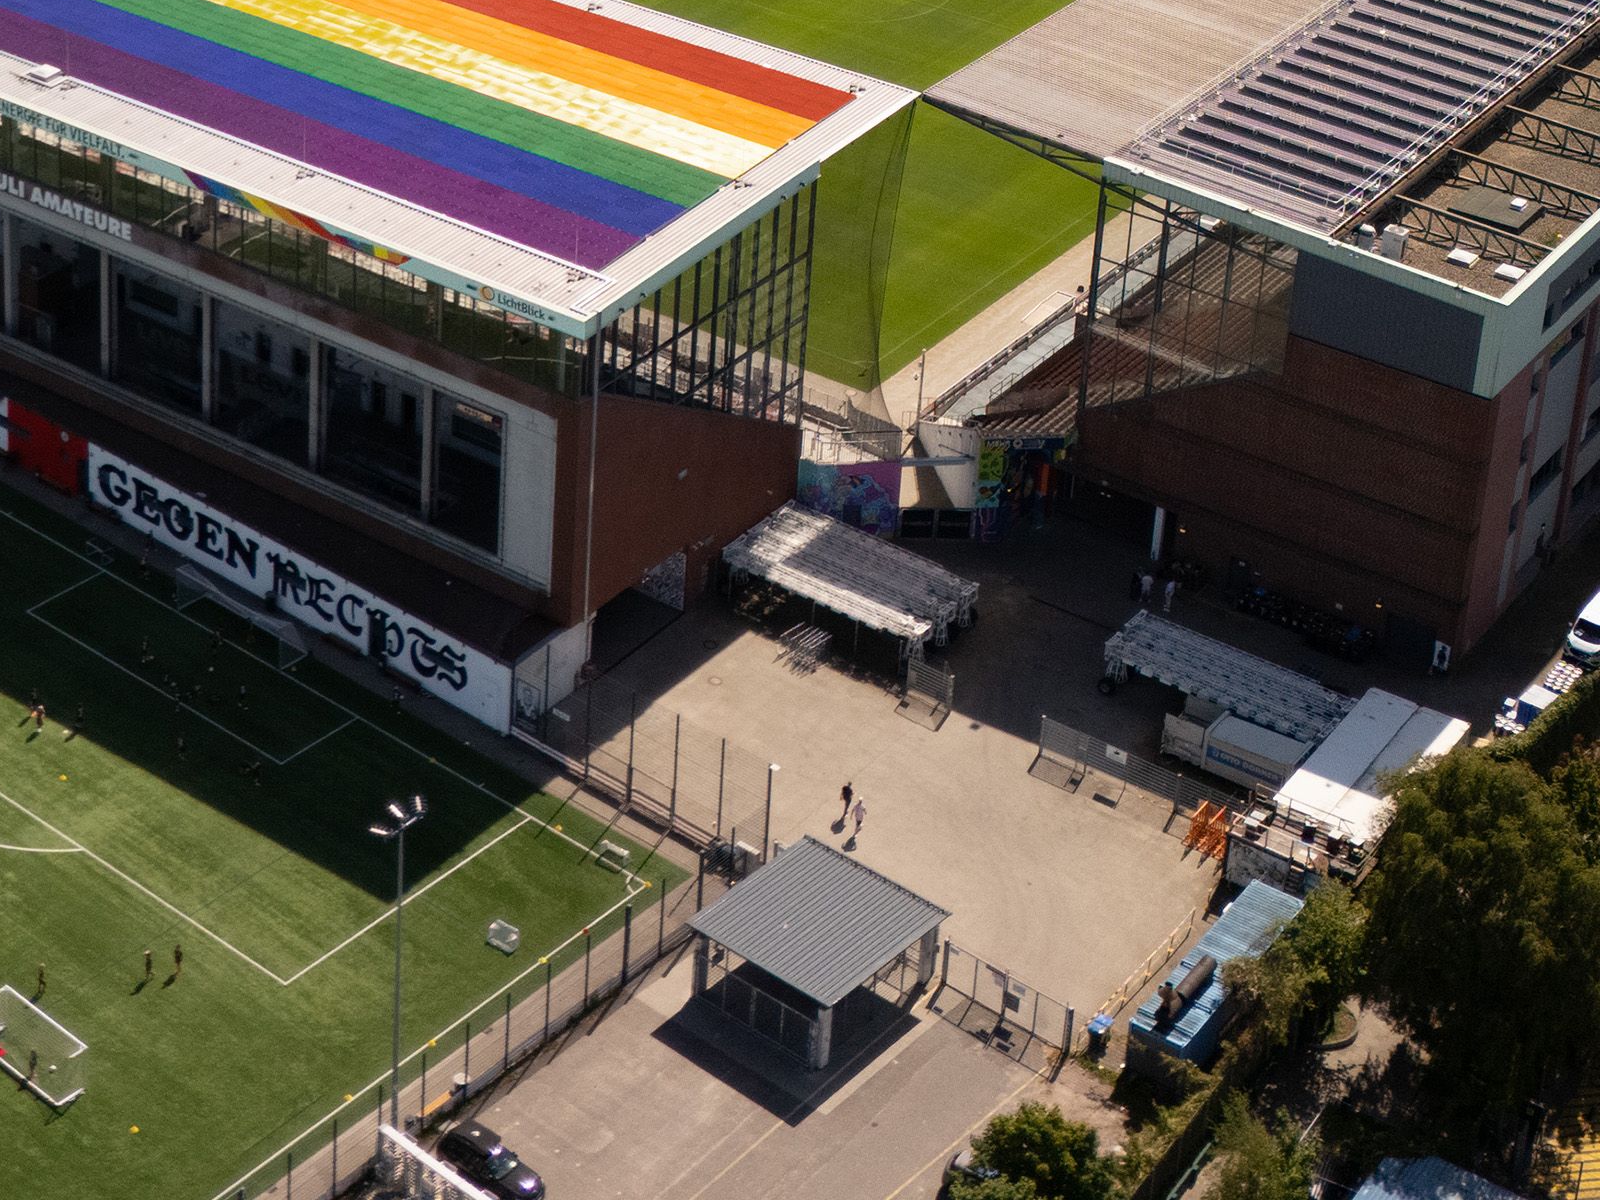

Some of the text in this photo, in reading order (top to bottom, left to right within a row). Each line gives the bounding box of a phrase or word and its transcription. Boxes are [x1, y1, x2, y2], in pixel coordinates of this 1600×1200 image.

[45, 115, 67, 136] FÜR
[69, 127, 126, 157] VIELFALT.
[30, 186, 133, 242] AMATEURE
[497, 293, 546, 320] LichtBlick
[97, 463, 261, 578] GEGEN
